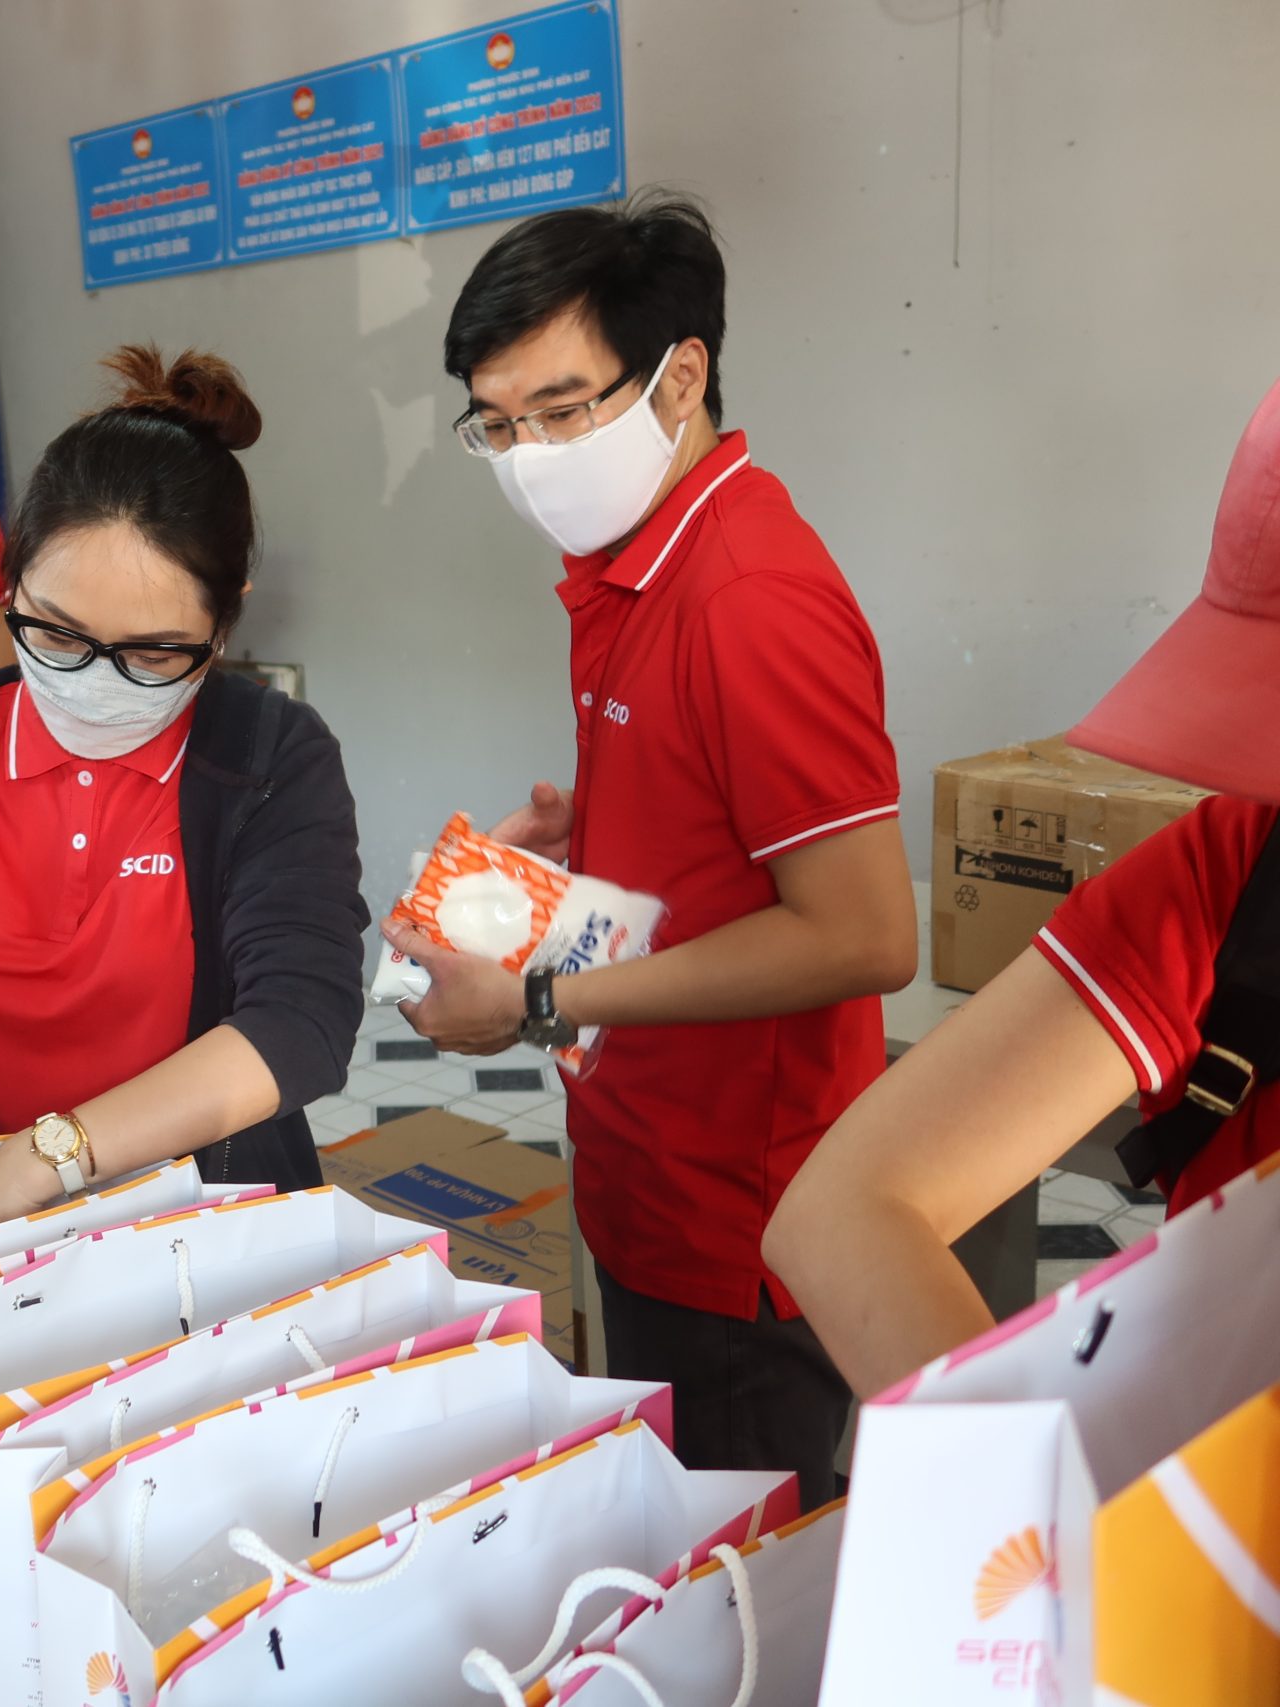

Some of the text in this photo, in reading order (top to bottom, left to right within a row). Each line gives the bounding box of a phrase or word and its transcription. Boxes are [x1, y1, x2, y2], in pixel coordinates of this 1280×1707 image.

[604, 697, 630, 725] SCID
[119, 854, 175, 877] SCID
[1019, 866, 1066, 884] KOHDEN
